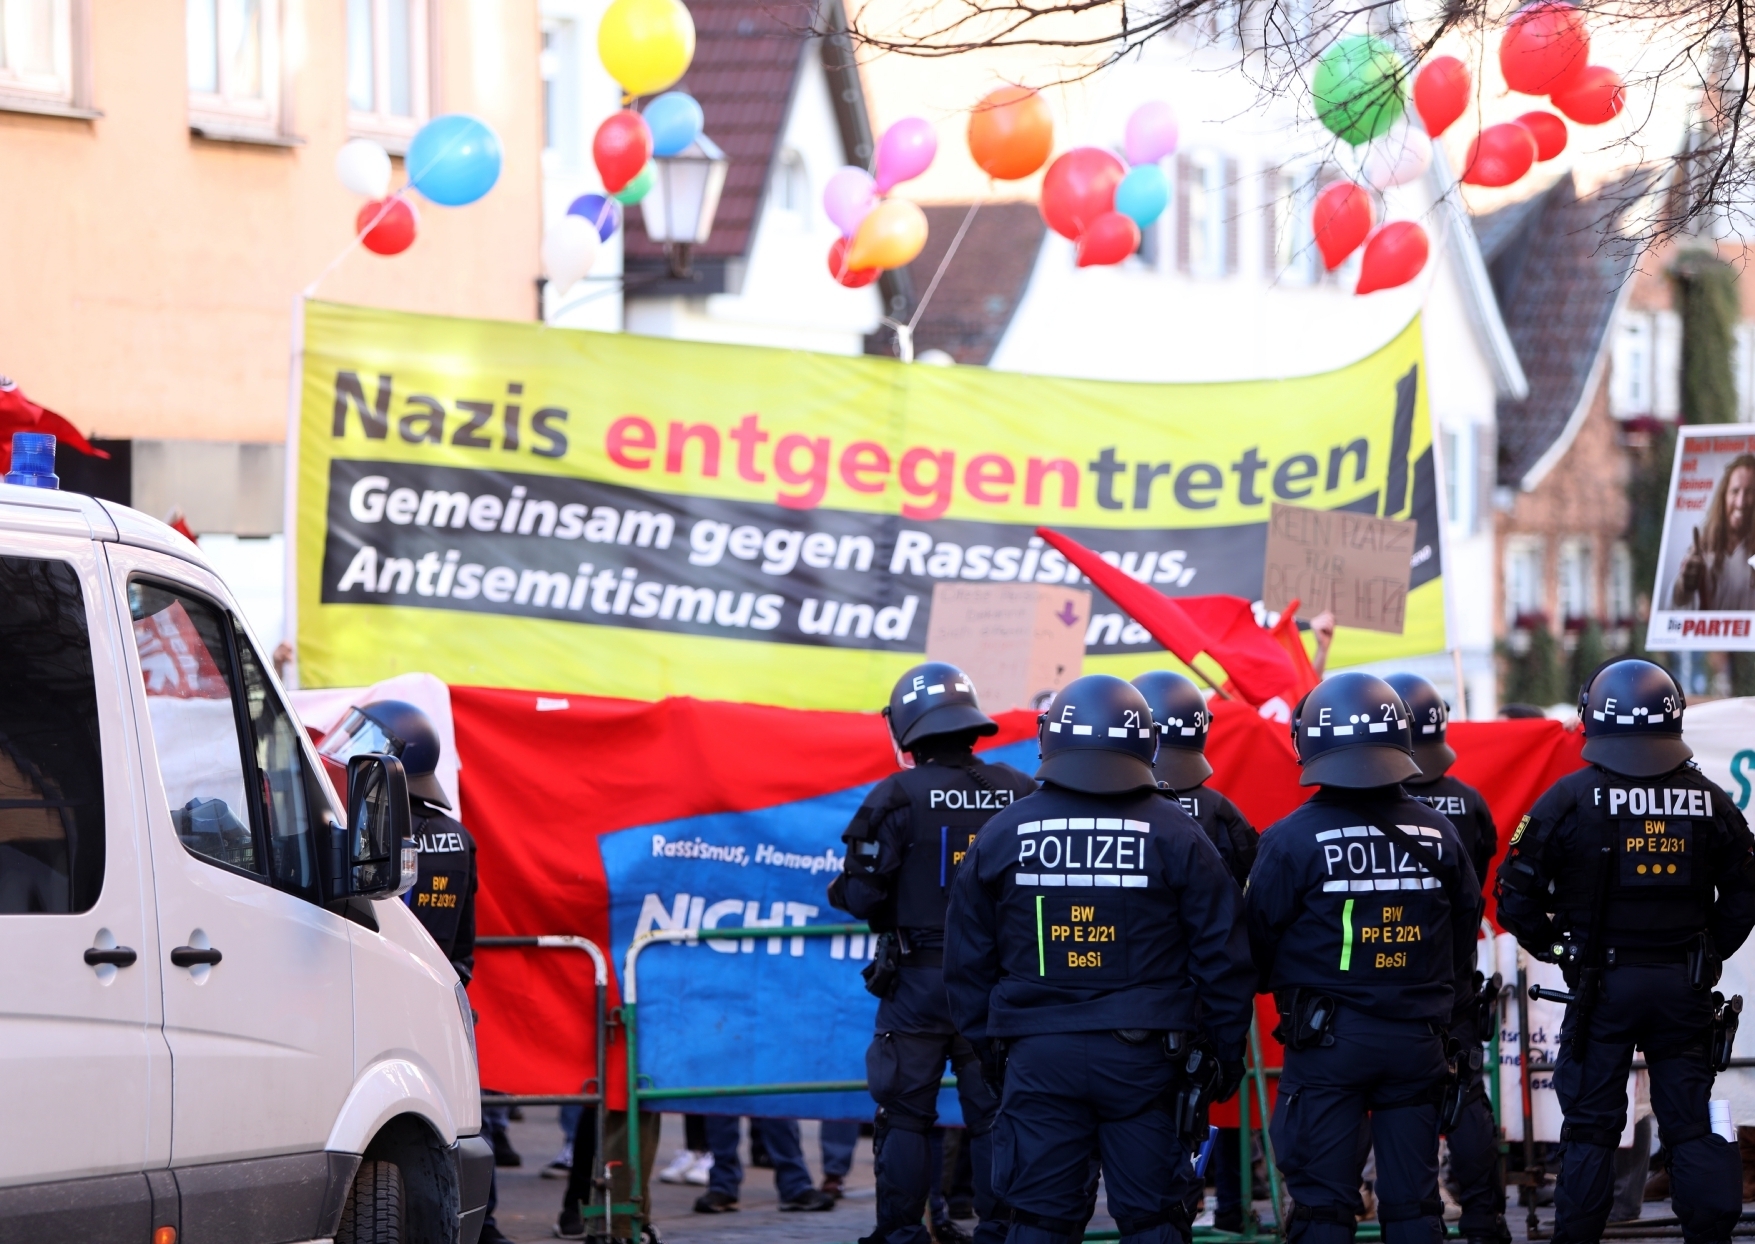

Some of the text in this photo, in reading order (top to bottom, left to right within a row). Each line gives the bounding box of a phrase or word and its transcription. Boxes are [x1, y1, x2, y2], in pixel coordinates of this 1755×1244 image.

[331, 363, 1418, 526] Nazis entgegentreten!
[349, 475, 676, 549] Gemeinsam
[689, 513, 876, 575] gegen
[1271, 504, 1411, 554] KEIN PLATZ
[337, 545, 920, 641] Antisemitismus und
[1682, 618, 1751, 637] PARTEI
[912, 675, 926, 691] E
[1319, 703, 1399, 726] E 21
[1604, 695, 1679, 715] E 31
[1060, 705, 1141, 729] E 21
[930, 789, 1015, 809] POLIZEI
[1609, 787, 1713, 818] POLIZEI
[1645, 820, 1665, 834] BW
[413, 833, 465, 853] OLIZEI
[1018, 836, 1145, 870] POLIZEI
[1626, 838, 1685, 852] PP E 2/31
[652, 834, 846, 876] Rassismus, Homopho
[432, 876, 448, 891] BW
[418, 893, 430, 907] PP
[1070, 906, 1095, 922] BW
[1382, 906, 1403, 923] BW
[632, 892, 819, 958] NICHT
[1051, 925, 1116, 942] PP E 2/21
[1361, 925, 1421, 943] PP E 2/21
[1067, 951, 1101, 968] BeSi
[1375, 952, 1406, 968] BeSi
